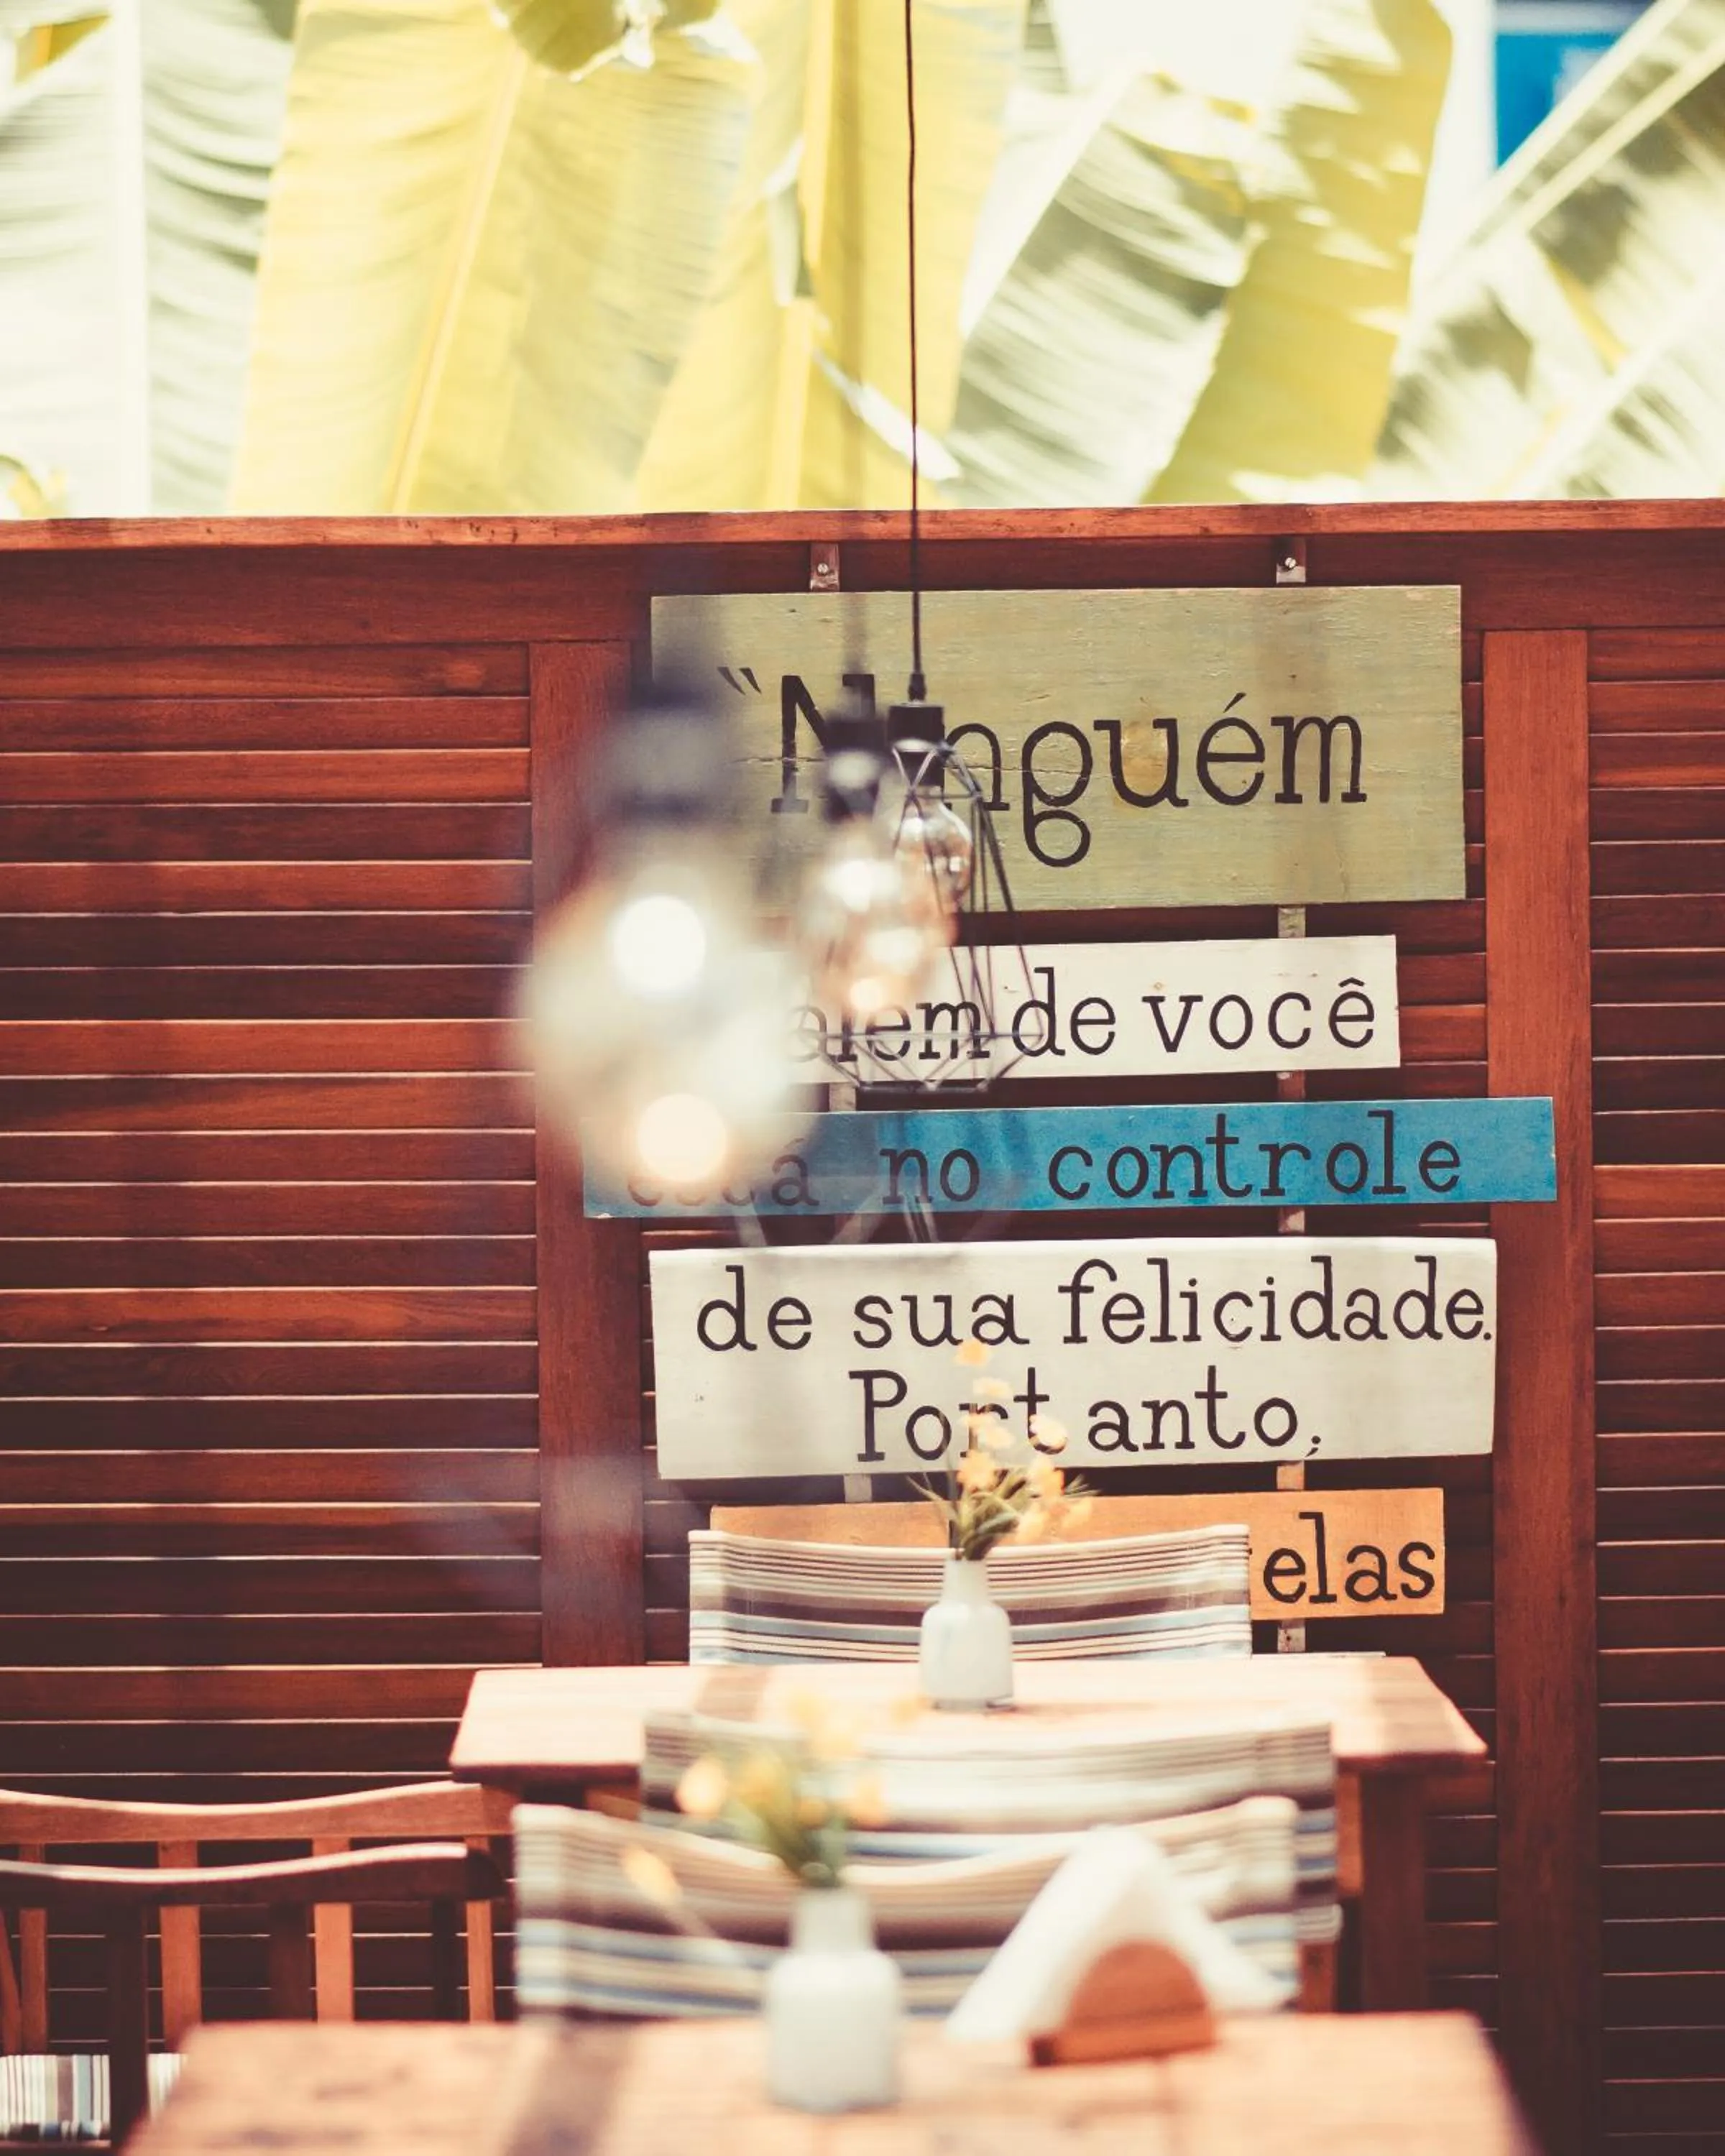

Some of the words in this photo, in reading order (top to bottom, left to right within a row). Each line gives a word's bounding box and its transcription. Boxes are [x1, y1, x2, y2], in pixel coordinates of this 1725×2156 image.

[1011, 967, 1116, 1058] de
[1141, 977, 1376, 1053] você
[878, 1148, 980, 1204] no
[1048, 1110, 1461, 1202] controle
[696, 1265, 813, 1352] de
[852, 1294, 1031, 1349] sua
[1057, 1256, 1492, 1345] felicidade.
[1249, 1511, 1436, 1604] elas
